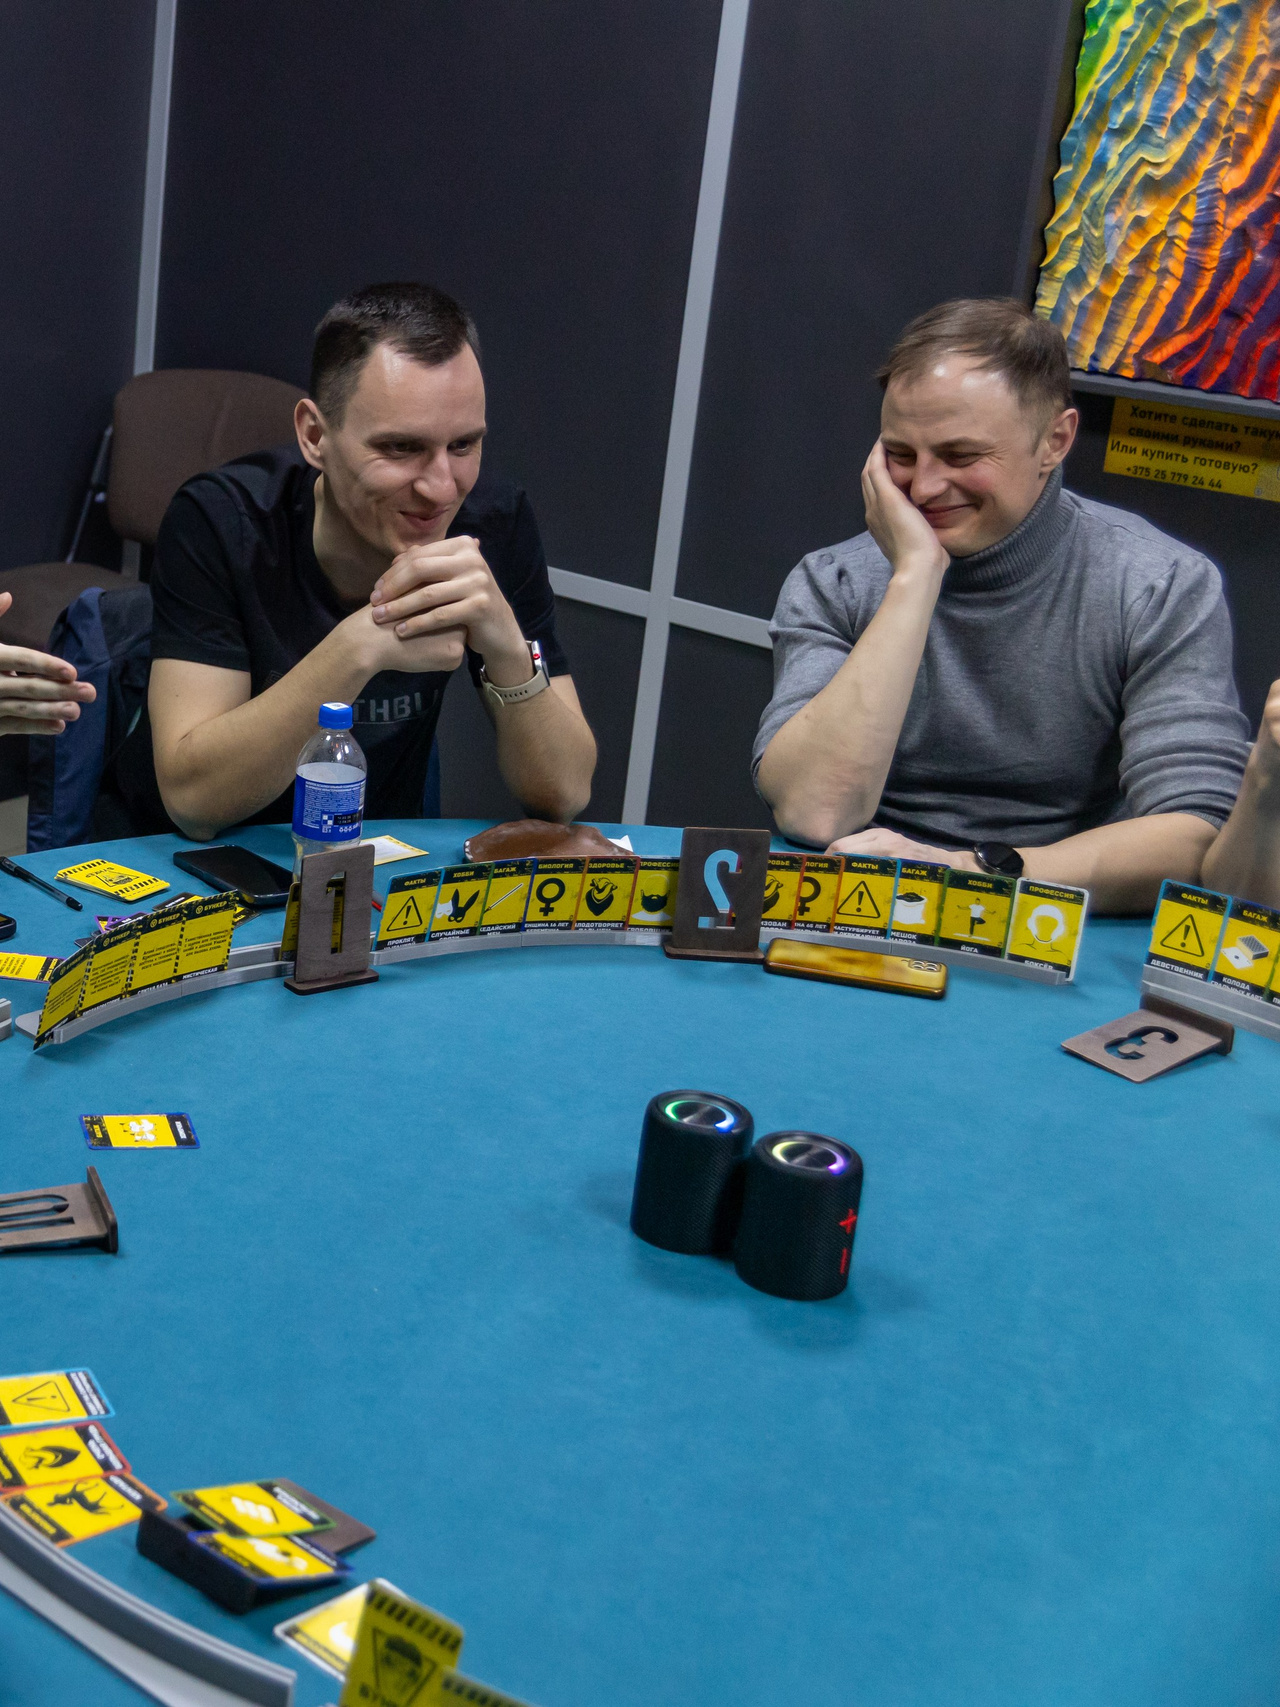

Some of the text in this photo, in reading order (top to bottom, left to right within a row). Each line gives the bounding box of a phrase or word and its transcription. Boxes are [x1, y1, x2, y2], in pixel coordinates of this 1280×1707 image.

[1130, 405, 1177, 424] Хотите
[1181, 416, 1238, 434] сделать
[1128, 426, 1179, 444] своими
[1110, 440, 1259, 475] Или купить готовую?
[1126, 465, 1223, 489] +375 25 779 24 44
[493, 866, 517, 874] БАГАЖ
[851, 861, 879, 870] ФАКТЫ
[453, 870, 475, 879] ХОББИ
[901, 867, 927, 877] БАГАЖ
[404, 878, 426, 886] ФАКТЫ
[967, 879, 993, 889] ХОББИ
[1029, 885, 1075, 900] ПРОФЕССИЯ
[1181, 892, 1209, 905] ФАКТЫ
[1243, 910, 1268, 923] БАГАЖ
[480, 923, 516, 932] ЕДАЙСКИЙ
[890, 931, 918, 940] МЕШОК
[960, 945, 979, 954] ЙОГА
[1150, 959, 1204, 979] ДЕВСТВЕННИК
[1222, 976, 1251, 991] КОЛОДА
